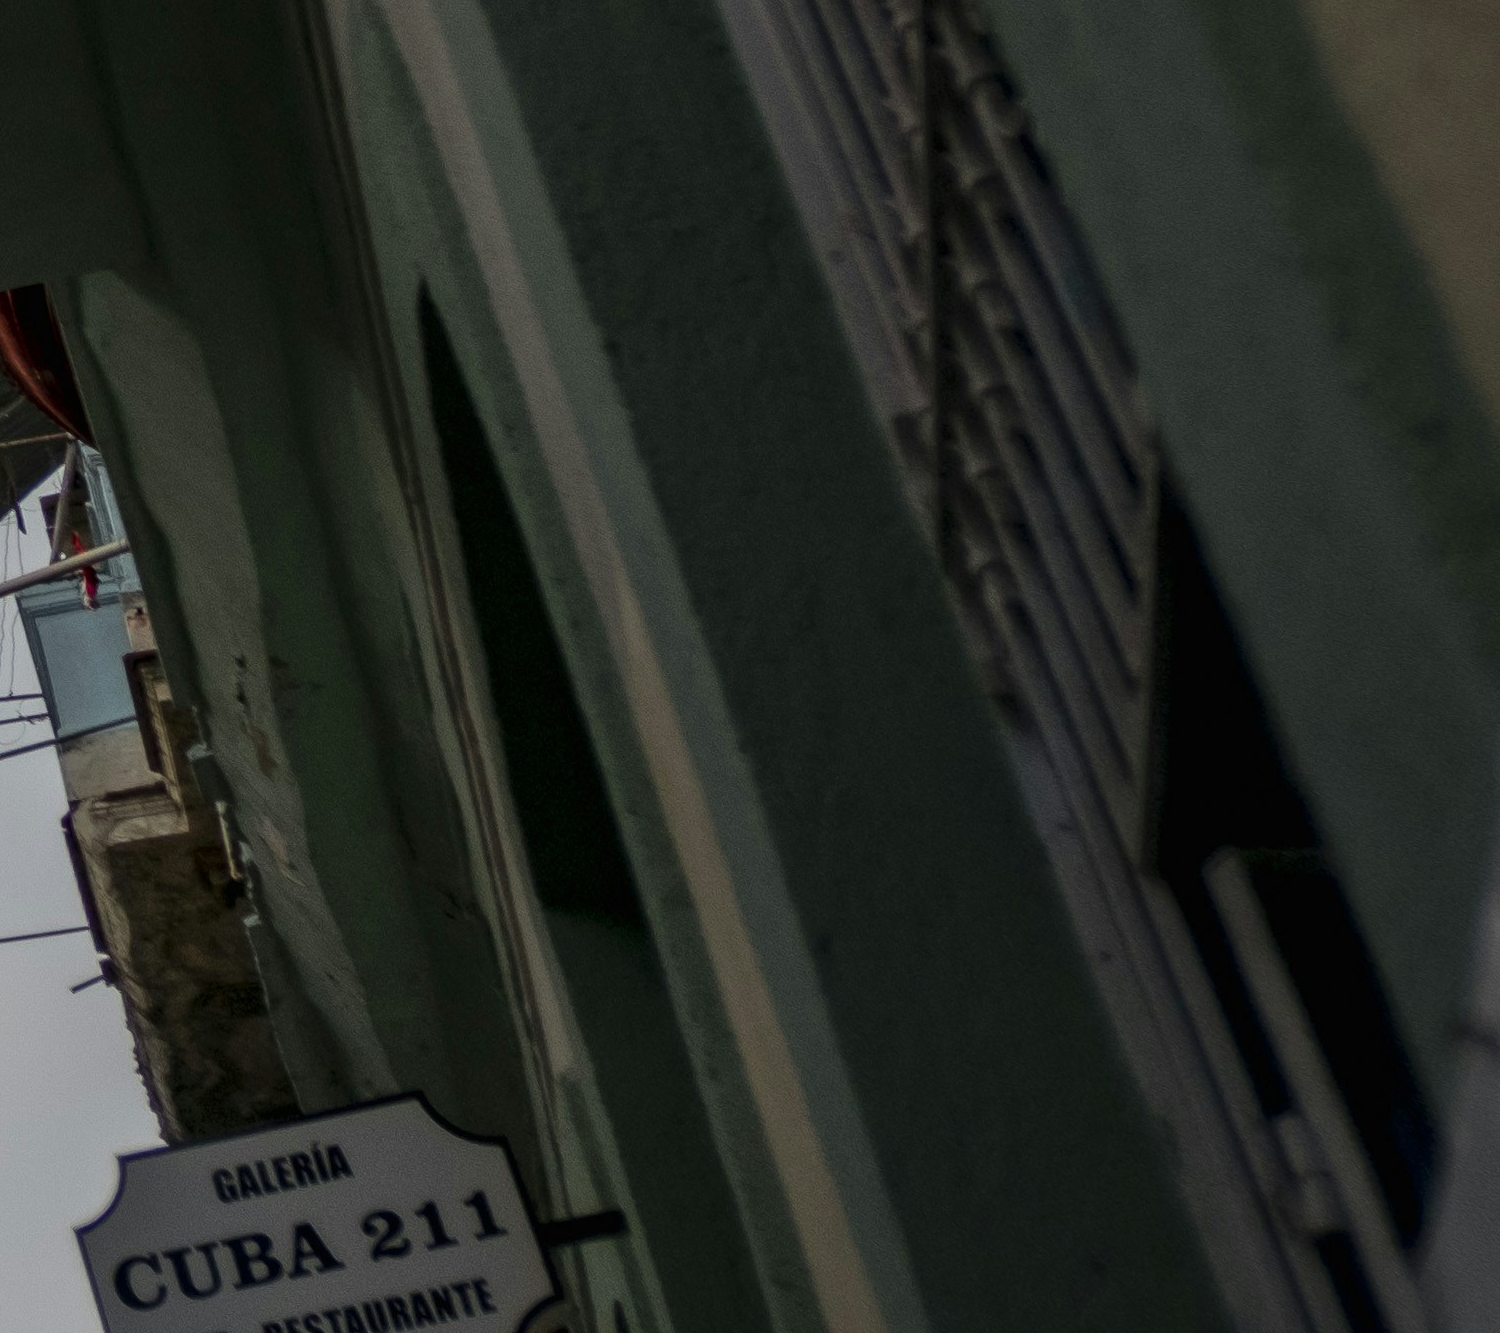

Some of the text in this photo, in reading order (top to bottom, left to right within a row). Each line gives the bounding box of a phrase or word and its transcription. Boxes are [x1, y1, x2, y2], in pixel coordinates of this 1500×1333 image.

[213, 1142, 353, 1203] GALERÍA
[114, 1190, 508, 1310] CUBA 211
